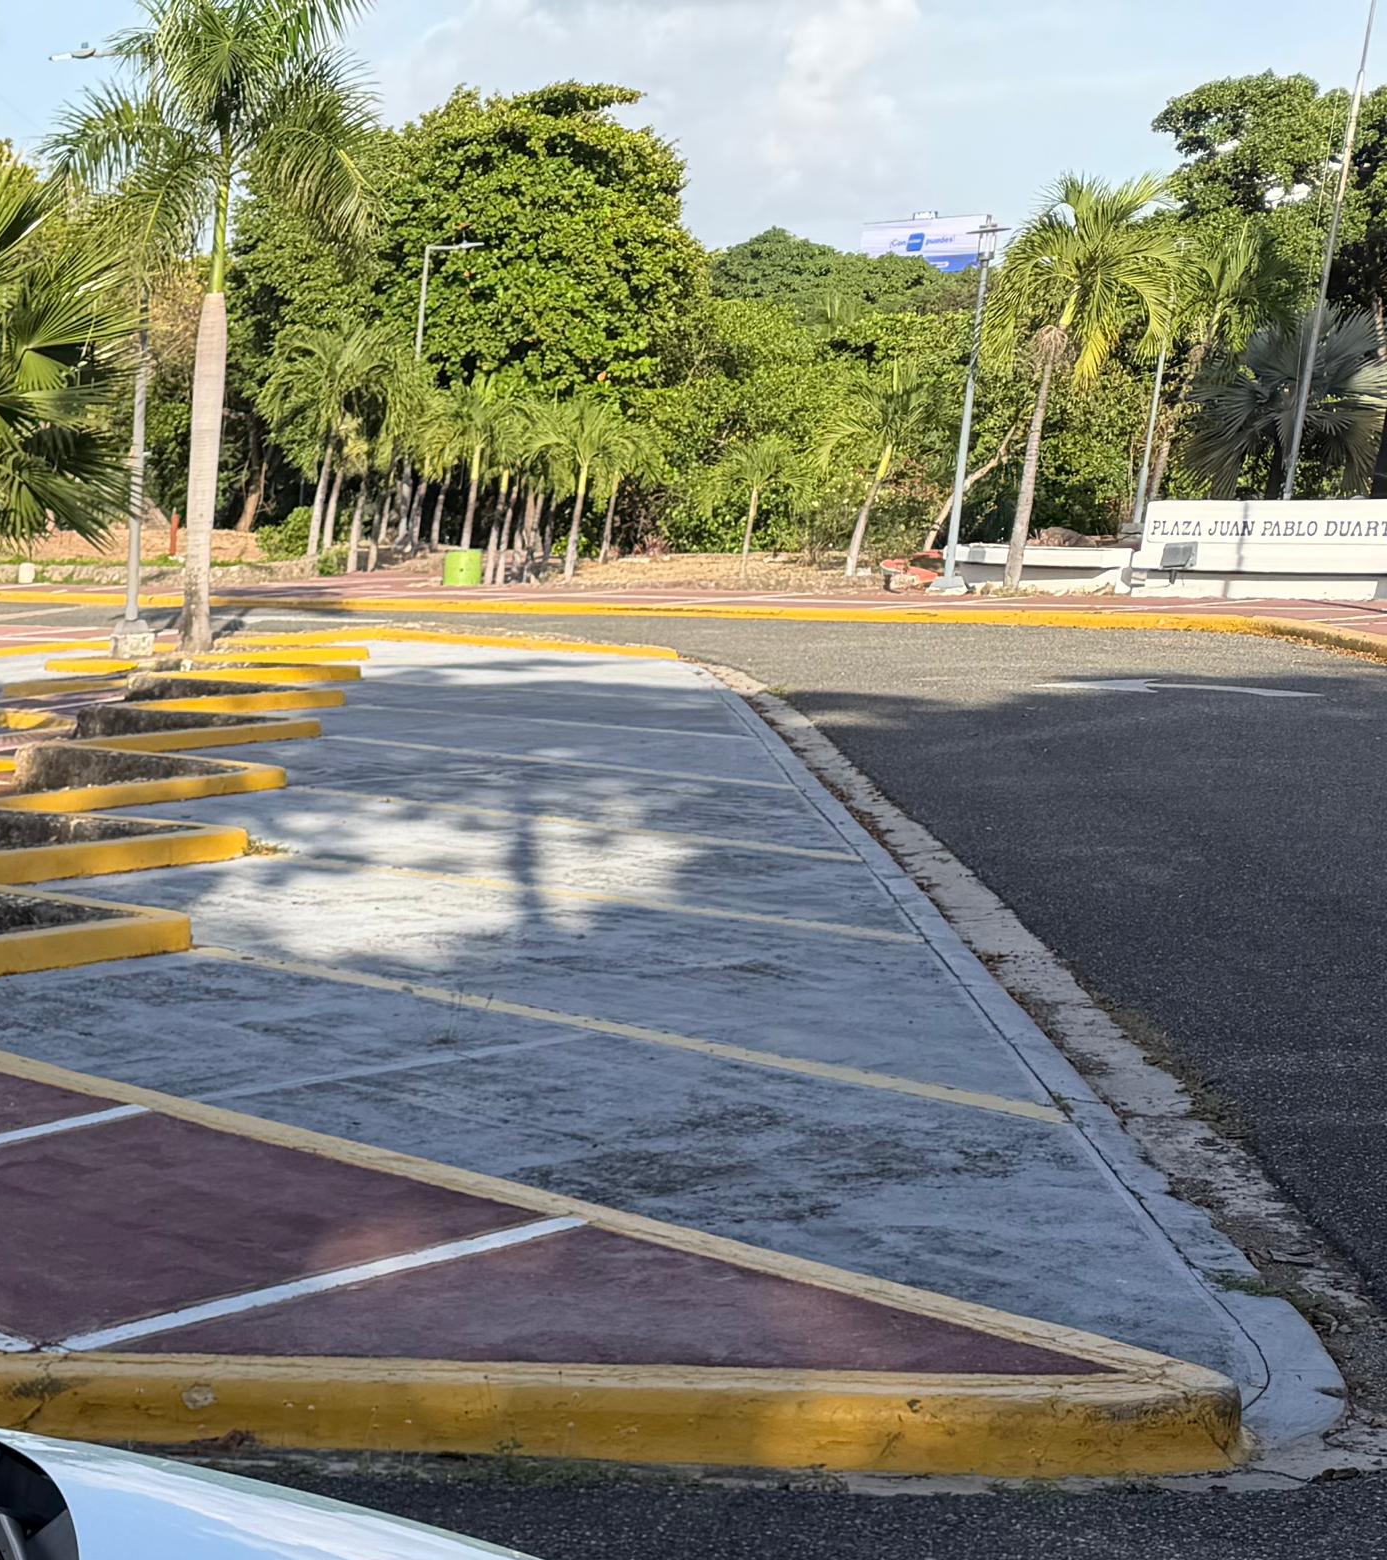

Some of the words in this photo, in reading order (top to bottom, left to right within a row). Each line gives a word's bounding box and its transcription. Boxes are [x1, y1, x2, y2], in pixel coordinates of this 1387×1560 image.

[1150, 520, 1202, 537] PLAZA
[1207, 520, 1255, 537] JUAN
[1261, 520, 1319, 537] PABLO
